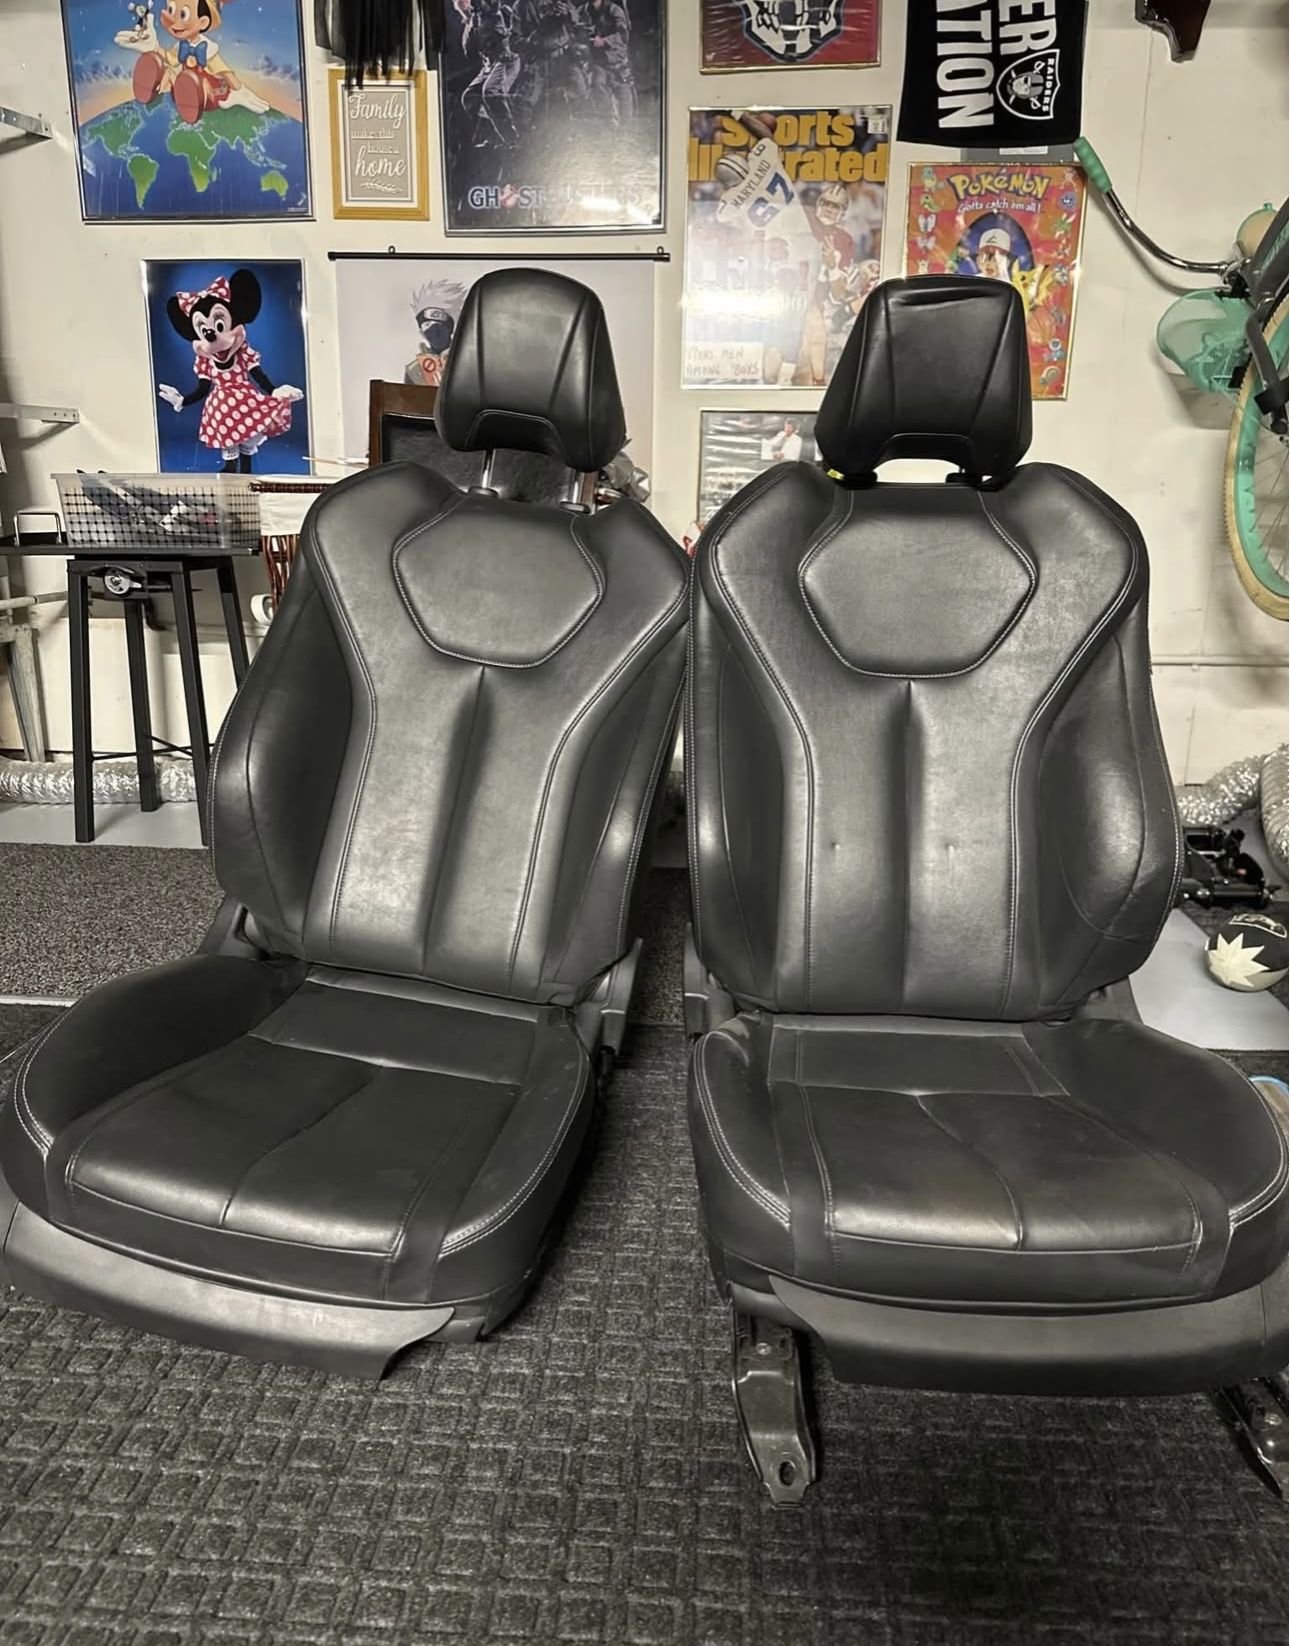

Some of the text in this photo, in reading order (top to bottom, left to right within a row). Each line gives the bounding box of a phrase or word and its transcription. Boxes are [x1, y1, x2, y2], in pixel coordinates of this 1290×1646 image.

[1042, 58, 1056, 112] RAIDERS
[348, 92, 407, 129] Family
[721, 111, 856, 147] Sorts
[355, 145, 407, 177] home
[688, 137, 889, 182] Illrated
[730, 159, 772, 209] MARYLAND
[747, 171, 795, 228] 67
[957, 200, 984, 213] Gotta
[985, 197, 1009, 209] catch
